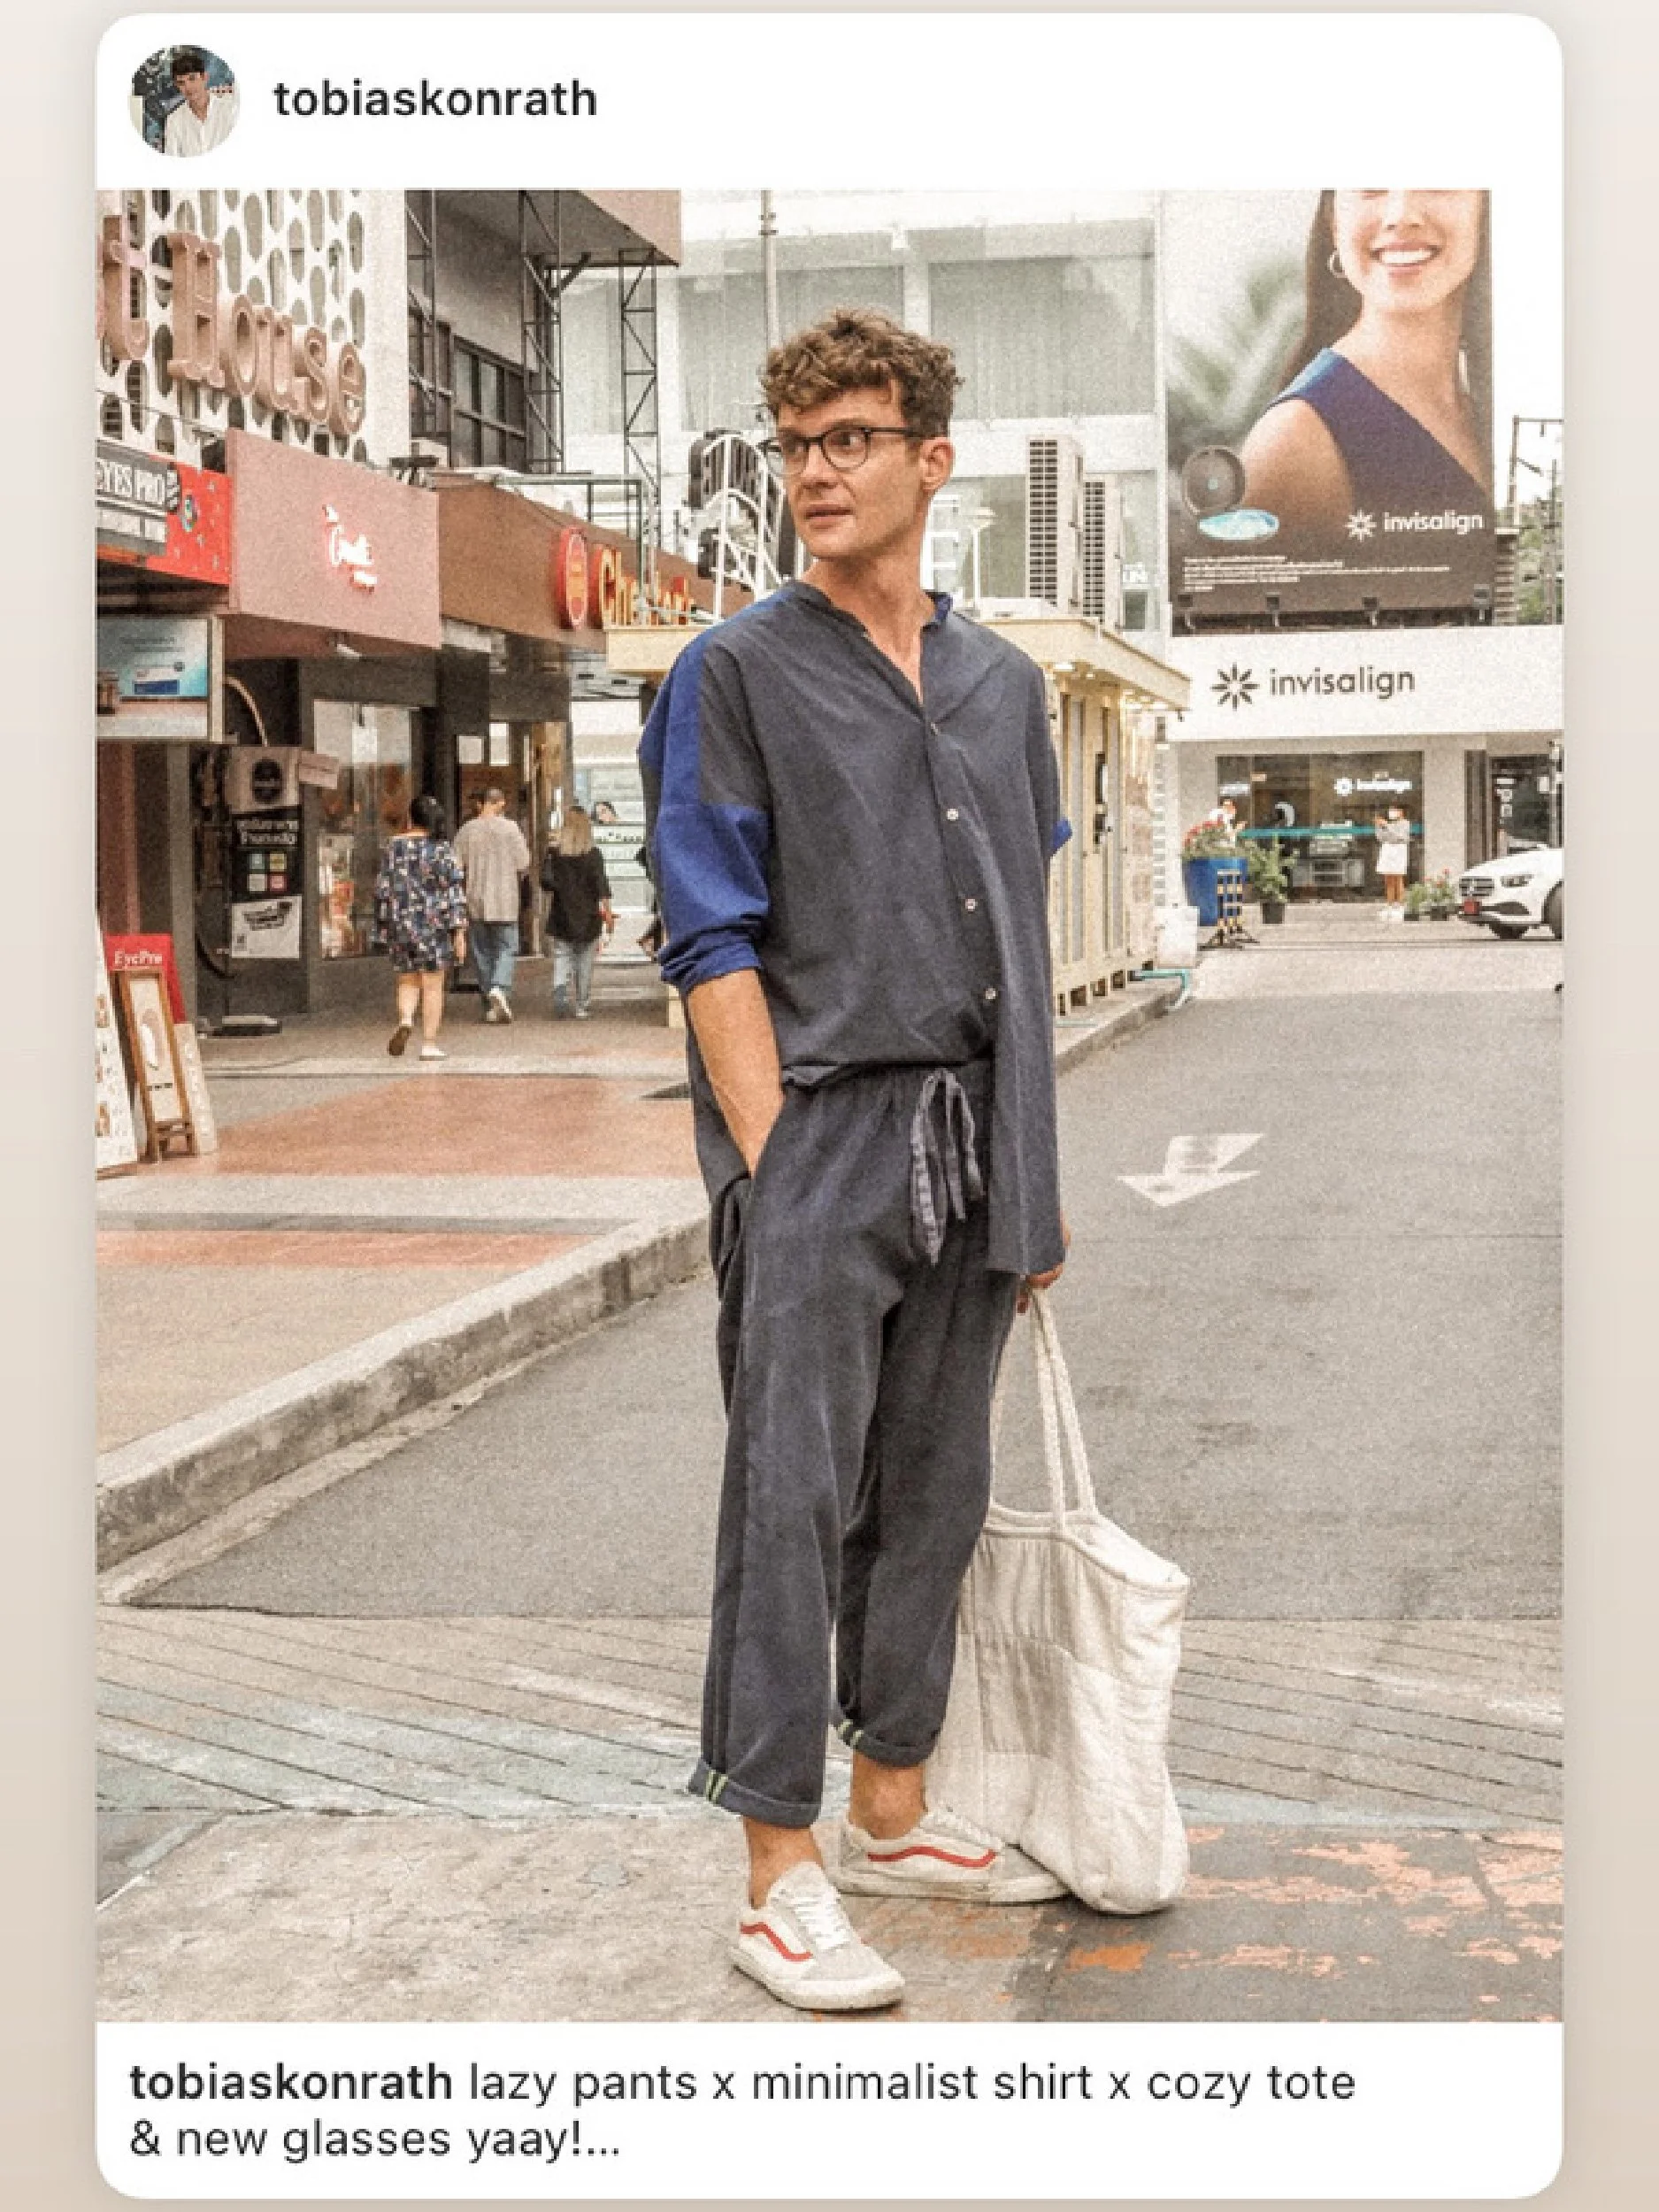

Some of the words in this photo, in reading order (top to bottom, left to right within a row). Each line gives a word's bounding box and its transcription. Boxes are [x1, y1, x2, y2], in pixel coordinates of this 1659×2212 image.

[167, 232, 366, 436] House
[134, 468, 165, 507] PRO
[1384, 511, 1484, 535] invisalign
[1269, 666, 1416, 700] invisalign
